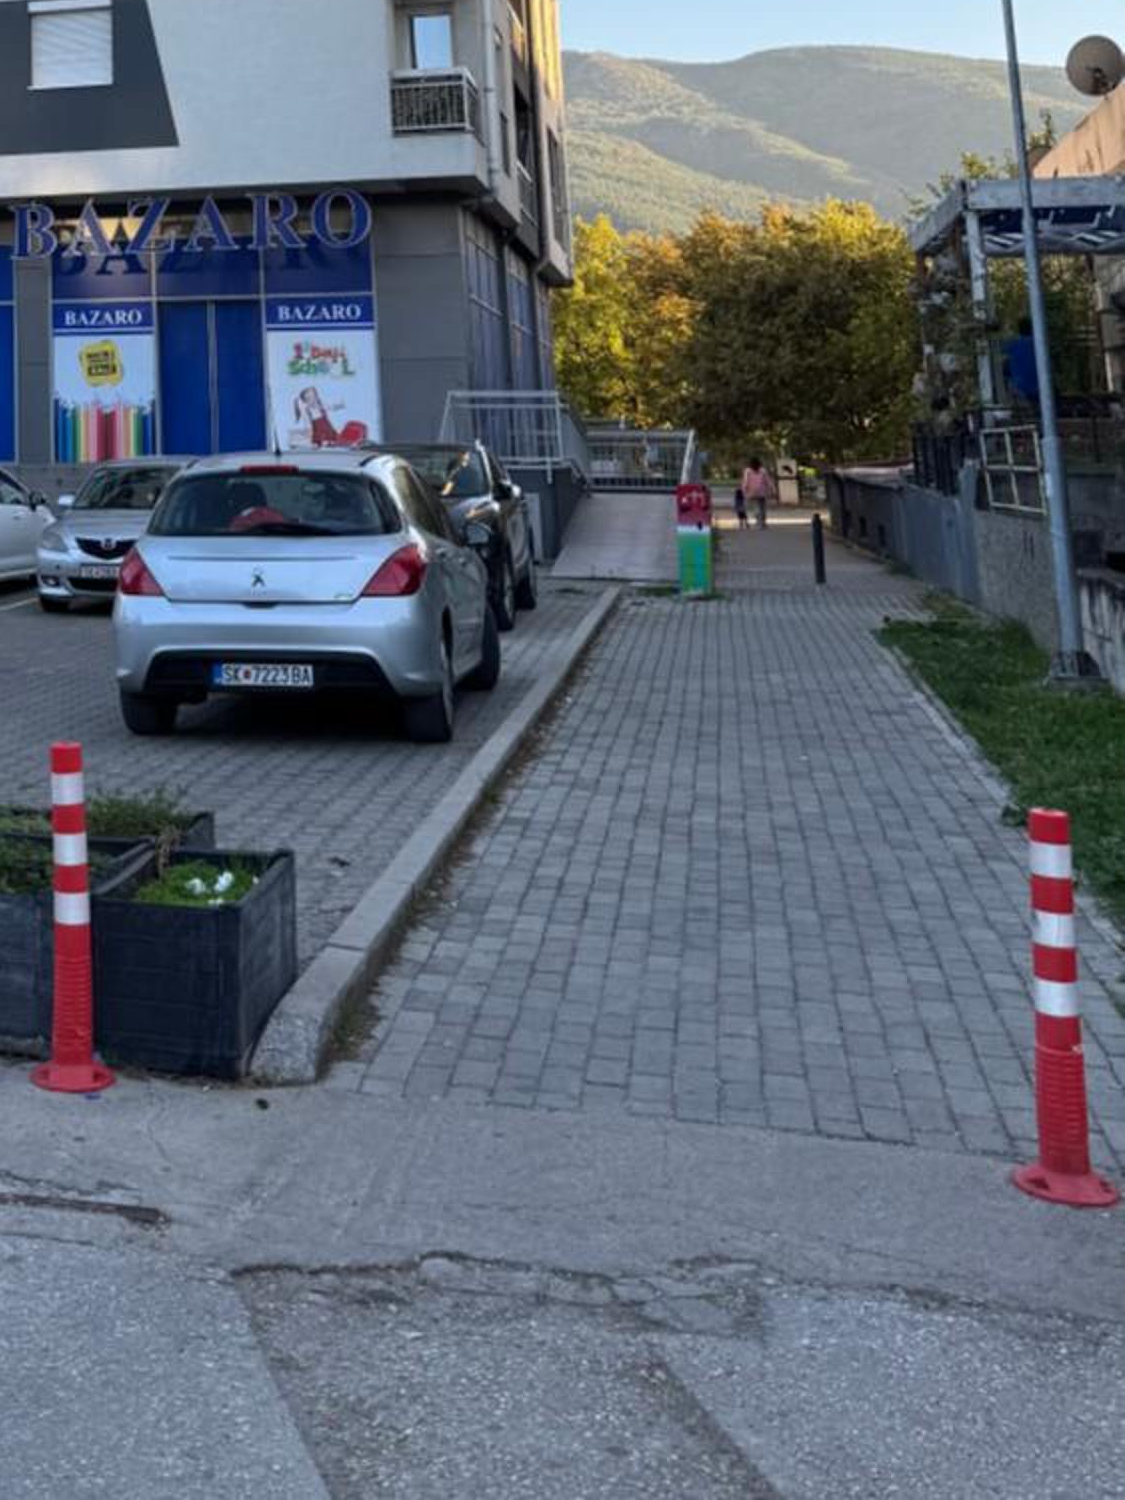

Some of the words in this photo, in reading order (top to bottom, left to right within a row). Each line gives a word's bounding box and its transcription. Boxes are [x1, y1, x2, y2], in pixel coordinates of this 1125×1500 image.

[11, 189, 372, 260] BAZARO
[64, 309, 143, 326] BAZARO
[277, 303, 362, 322] BAZARO
[224, 664, 242, 683] SK
